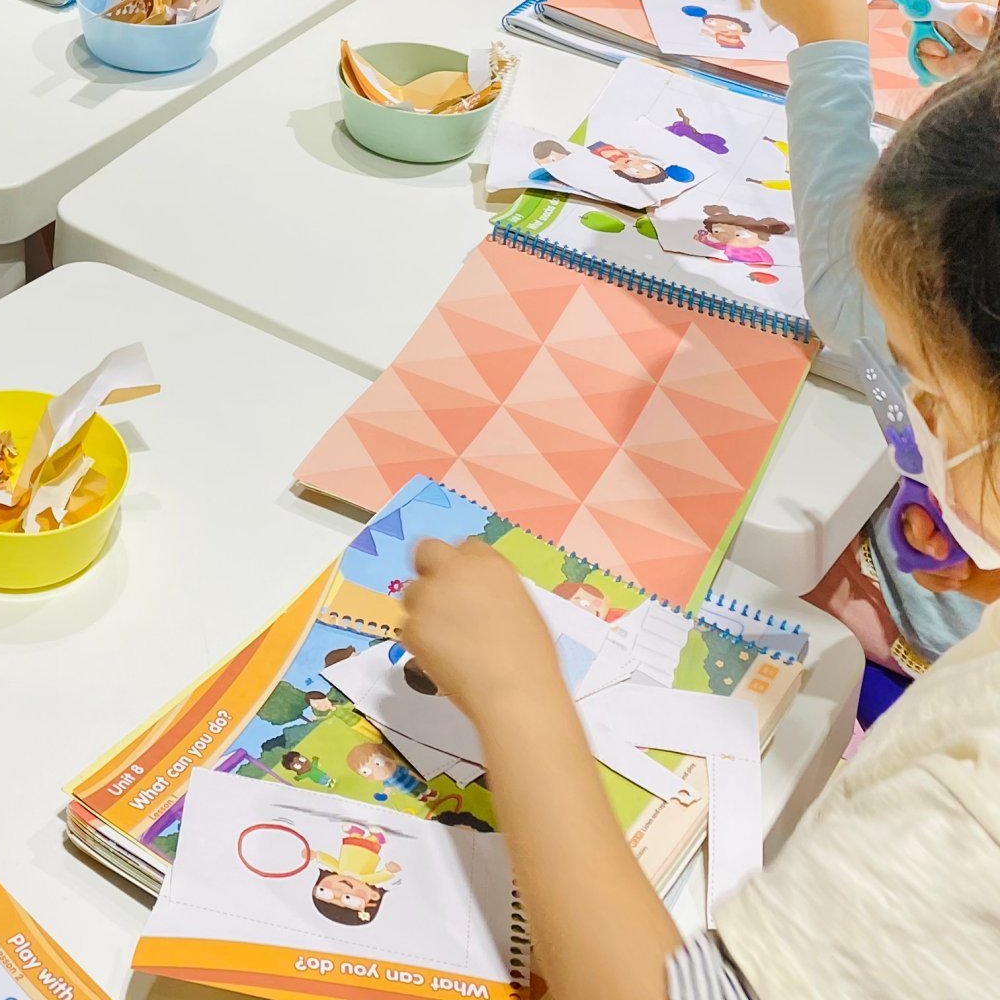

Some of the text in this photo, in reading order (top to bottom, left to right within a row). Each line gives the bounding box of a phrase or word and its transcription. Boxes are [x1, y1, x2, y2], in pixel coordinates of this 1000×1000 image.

[128, 710, 233, 810] What can you do?
[107, 764, 145, 796] Unit 8
[148, 799, 173, 821] Lesson
[7, 933, 75, 1000] Play with
[15, 974, 24, 983] 2
[294, 955, 490, 1000] What can you do?
